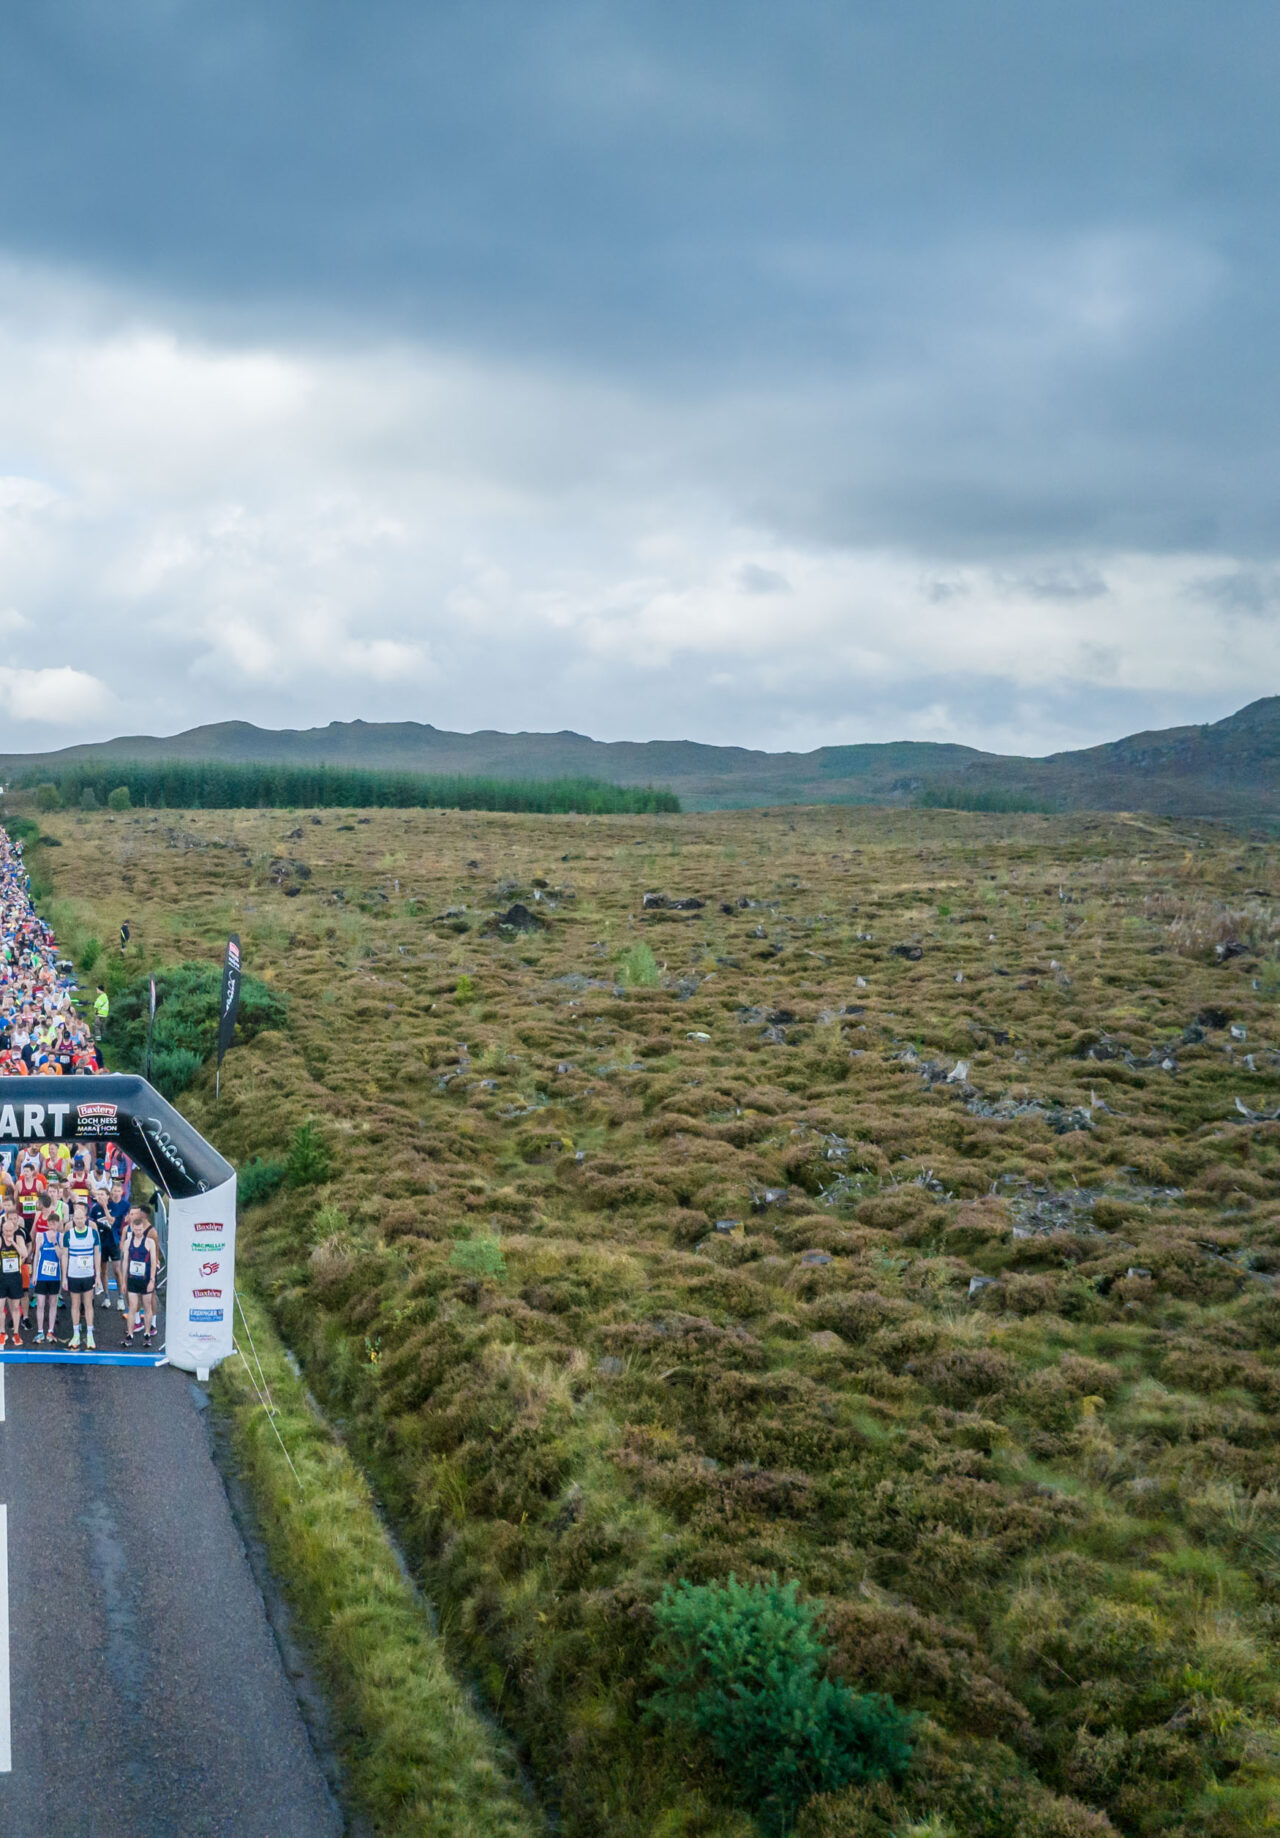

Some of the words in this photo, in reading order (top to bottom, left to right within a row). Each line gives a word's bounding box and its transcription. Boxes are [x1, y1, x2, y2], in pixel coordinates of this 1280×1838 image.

[80, 1104, 116, 1115] Baxters
[77, 1117, 98, 1125] LOCH
[100, 1117, 118, 1125] NESS
